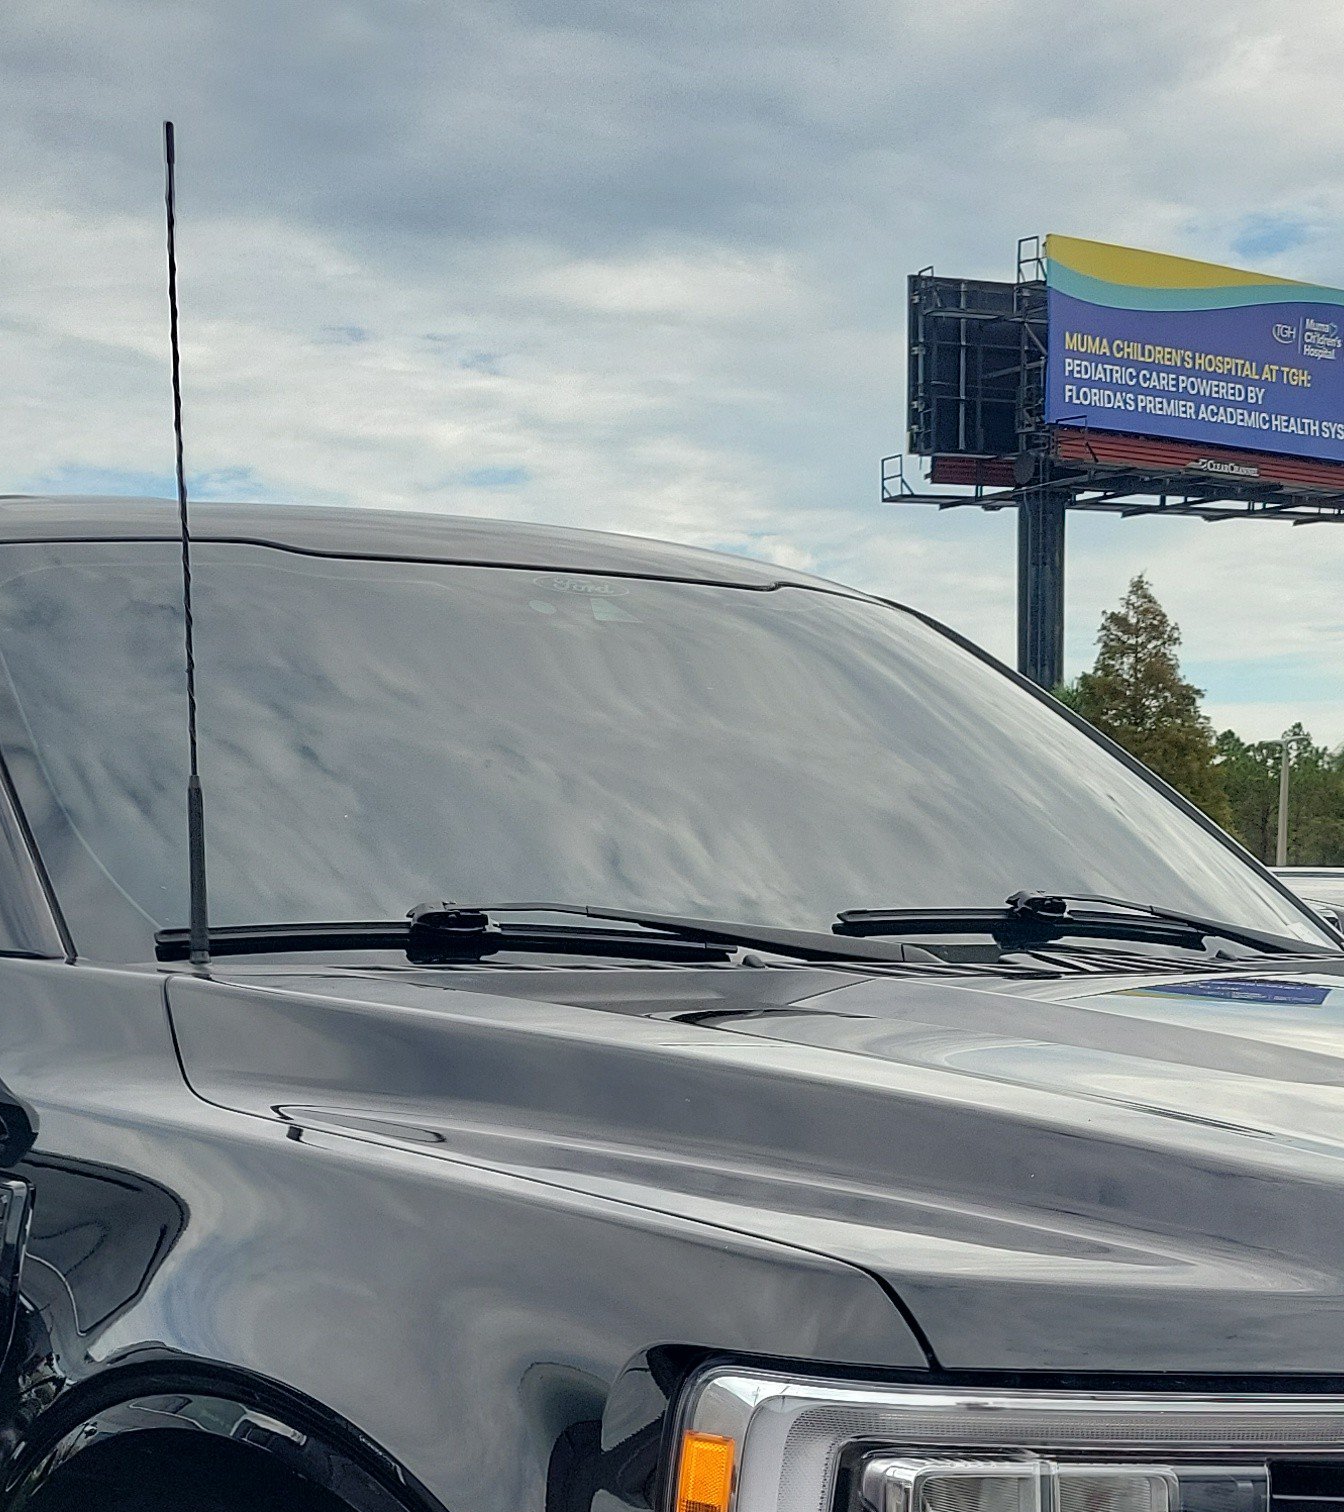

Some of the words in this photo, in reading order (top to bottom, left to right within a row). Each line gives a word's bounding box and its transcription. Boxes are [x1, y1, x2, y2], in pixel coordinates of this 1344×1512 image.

[1275, 323, 1296, 339] TGH
[1306, 318, 1329, 333] Muma
[1304, 331, 1342, 348] Children's
[1065, 331, 1110, 356] MUMA
[1113, 339, 1194, 368] CHILDREN'S
[1195, 352, 1259, 379] HOSPITAL
[1261, 364, 1279, 382] AT
[1281, 367, 1312, 387] TGH:
[1303, 344, 1336, 360] Hospital
[1064, 358, 1137, 386] PEDIATRIC
[1139, 370, 1177, 392] CARE
[1179, 375, 1245, 401] POWERED
[1247, 386, 1265, 404] BY
[1064, 384, 1135, 411] FLORIDA'S
[1137, 394, 1196, 419] PREMIER
[1198, 403, 1269, 430] ACADEMIC
[1272, 414, 1320, 437] HEALTH
